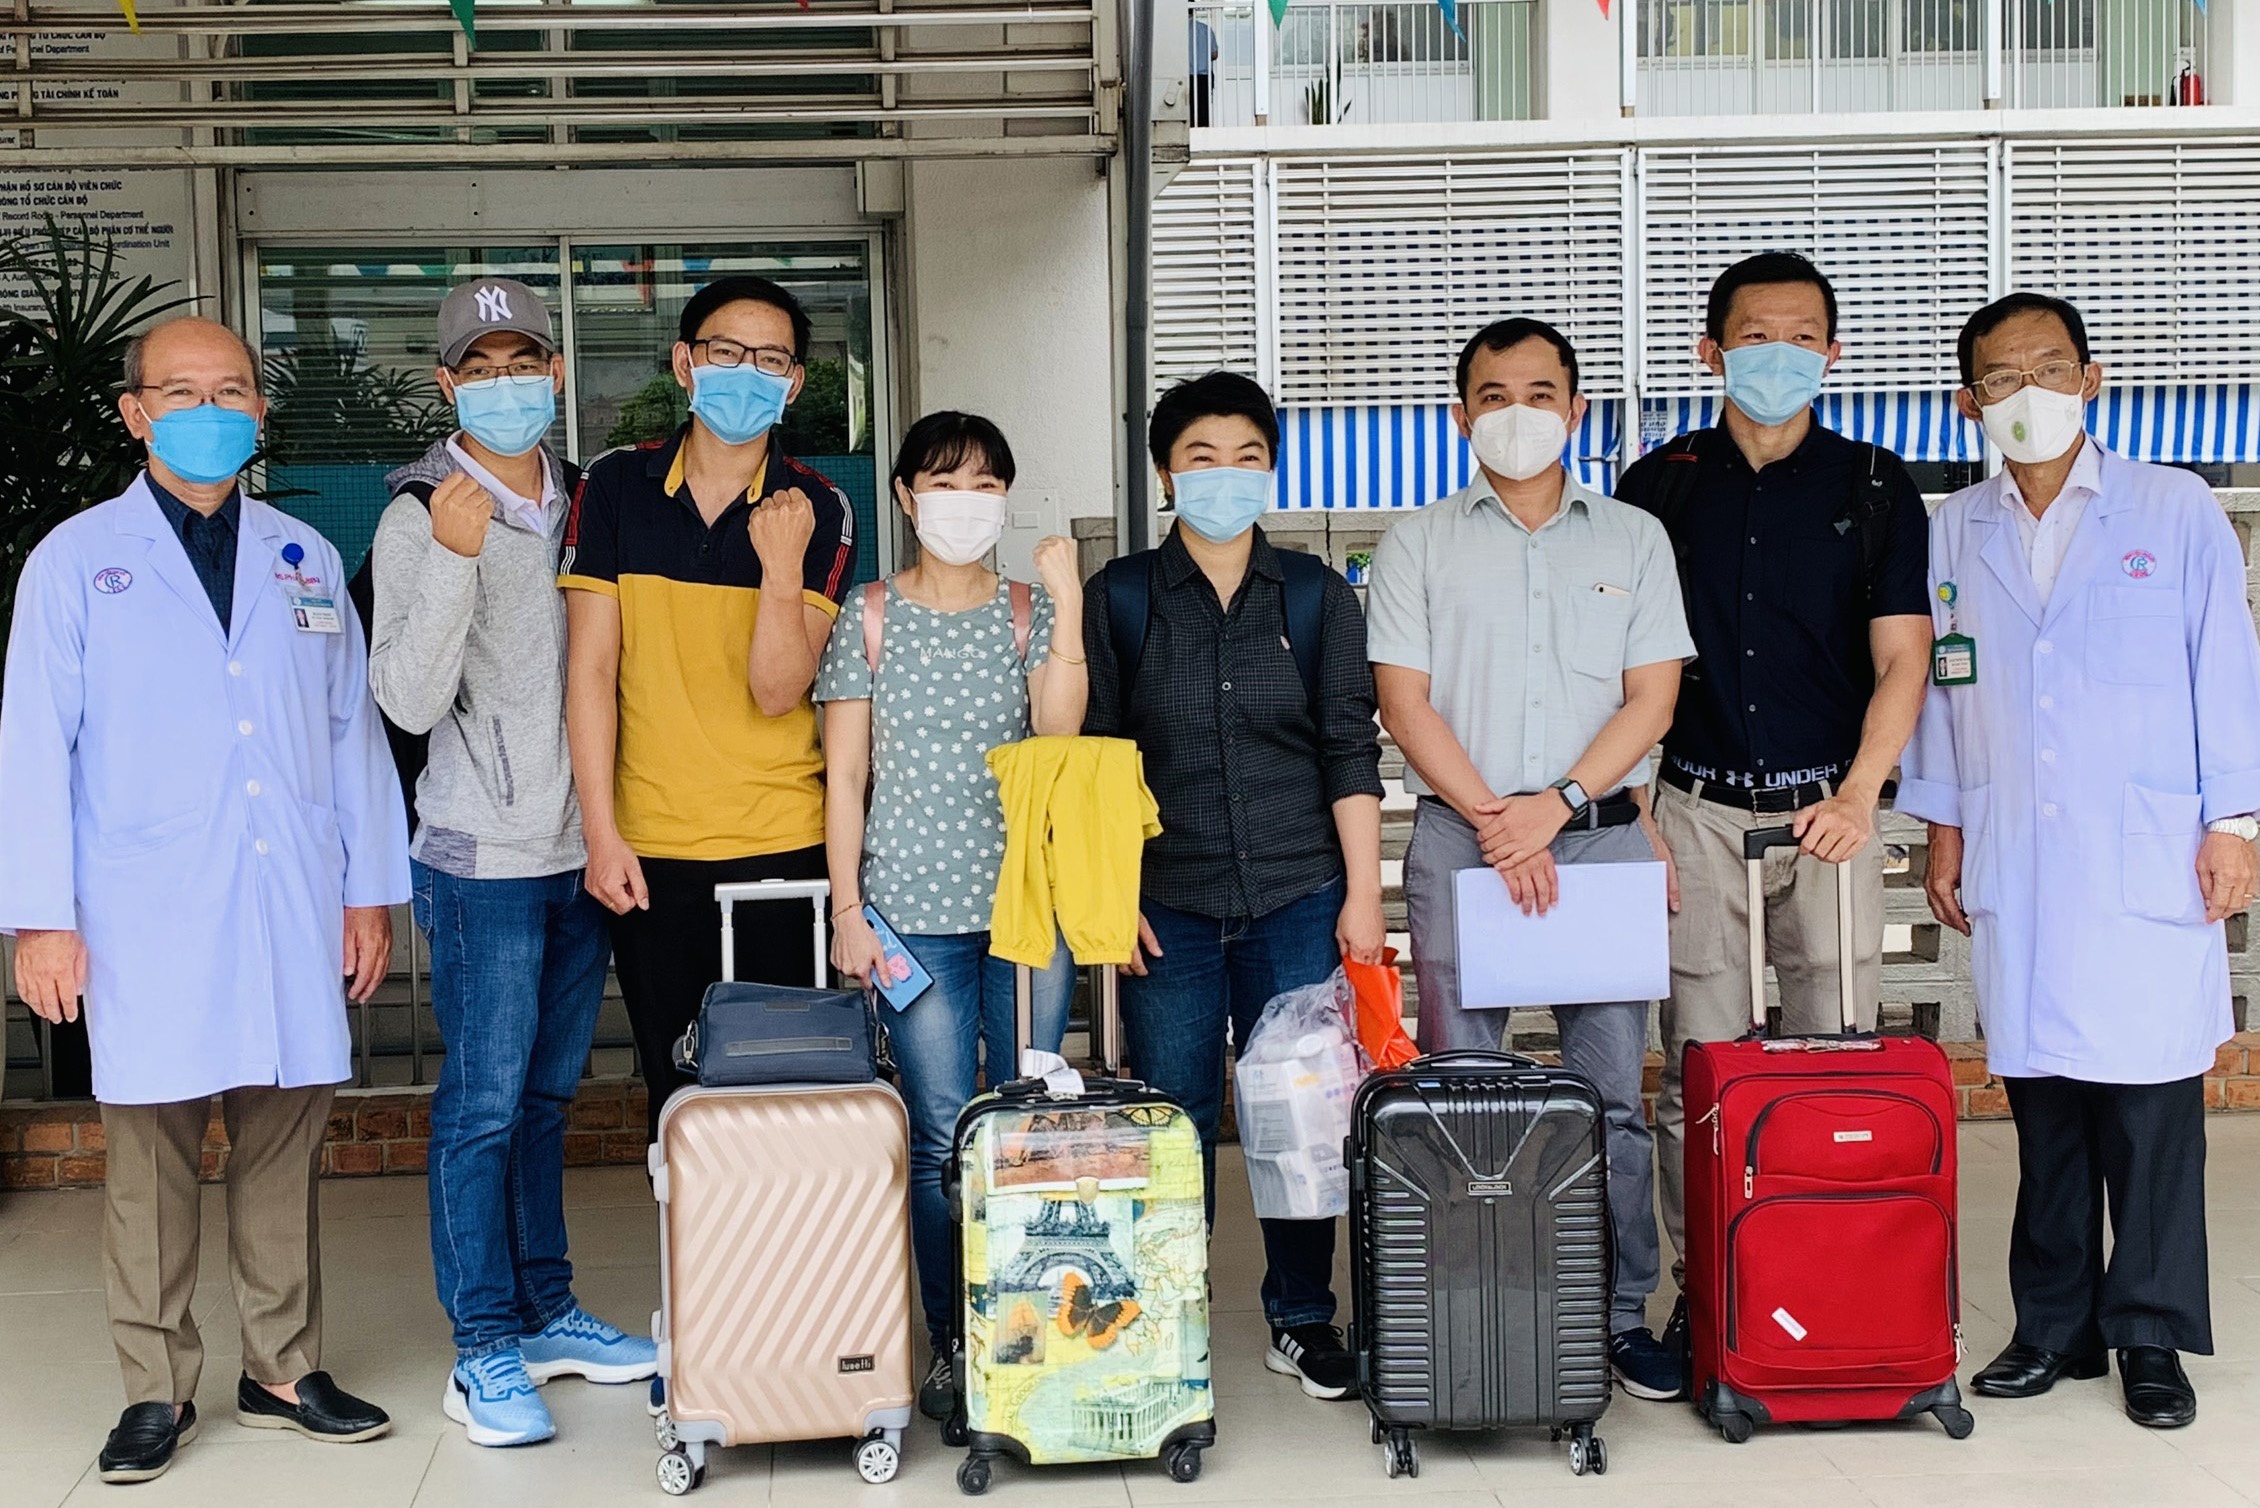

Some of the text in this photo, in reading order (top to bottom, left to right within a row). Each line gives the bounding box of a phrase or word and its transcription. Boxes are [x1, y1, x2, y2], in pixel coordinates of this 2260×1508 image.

[46, 44, 90, 54] Department
[2, 212, 30, 220] Record
[100, 210, 144, 220] Department
[153, 240, 170, 249] Unit
[1765, 764, 1838, 788] UNDER
